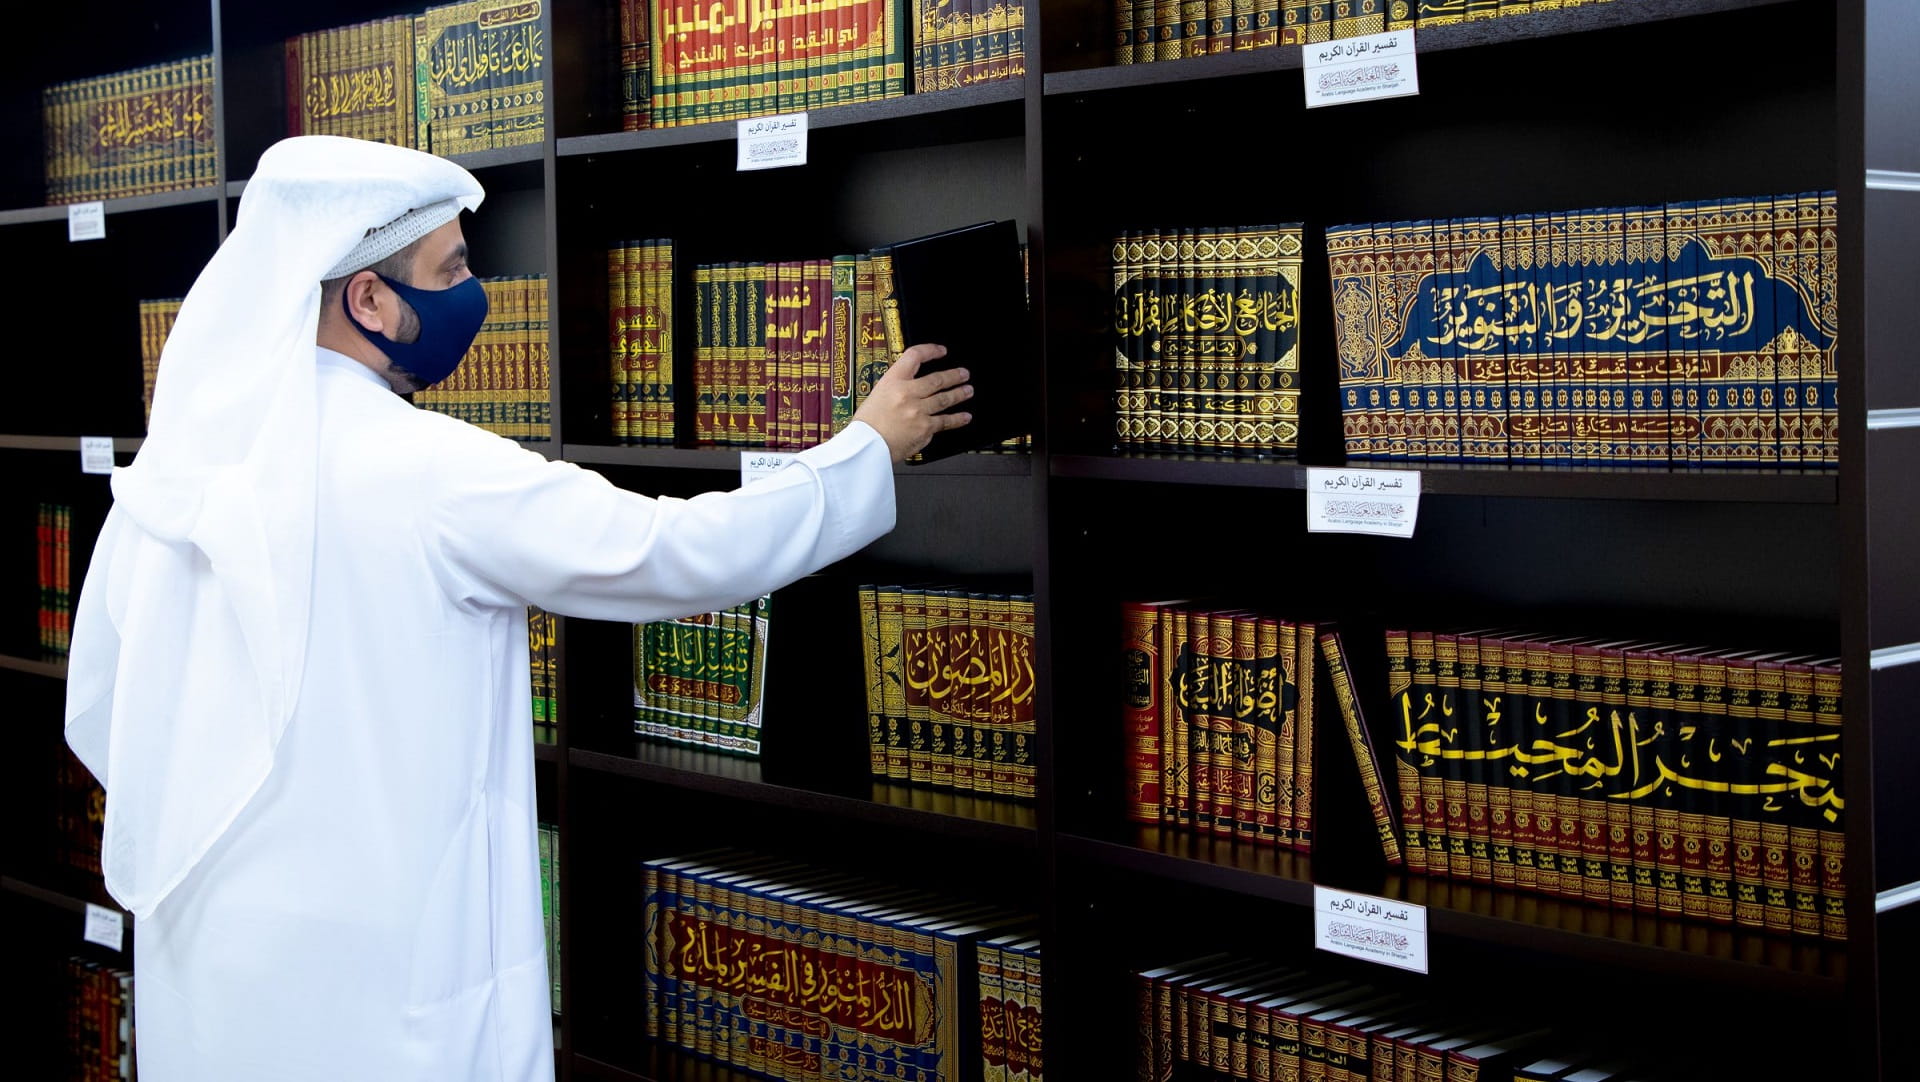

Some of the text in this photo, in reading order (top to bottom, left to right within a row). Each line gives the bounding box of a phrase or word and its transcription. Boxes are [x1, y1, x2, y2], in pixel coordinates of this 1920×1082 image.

[1318, 38, 1398, 63] تفسير القرآن الكريم
[1631, 421, 1695, 436] مؤسسة
[767, 457, 782, 469] القرآن
[1324, 475, 1402, 491] تفسير القرآن الكريم
[1330, 899, 1408, 921] تفسير القرآن الكريم
